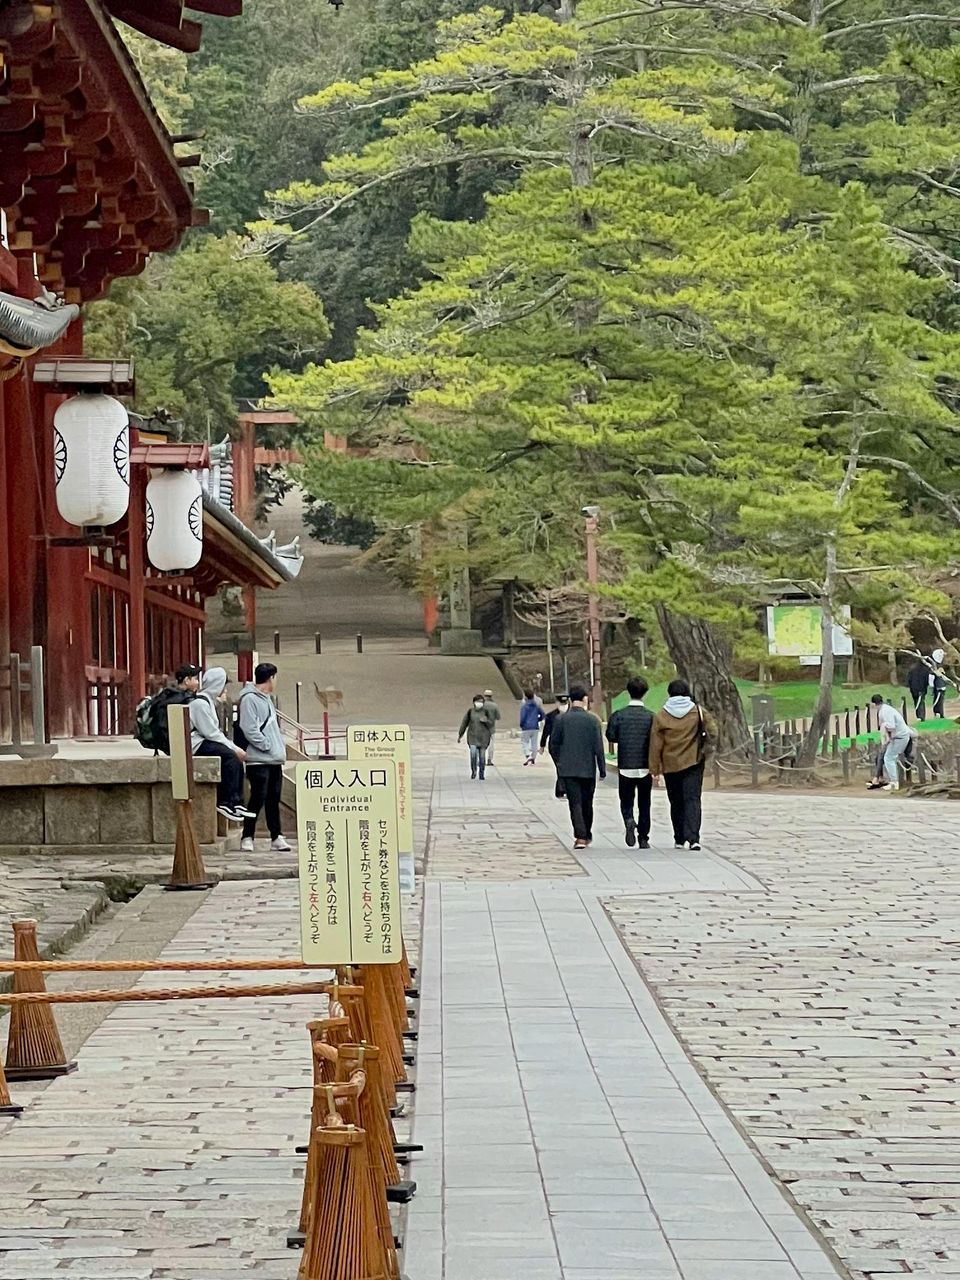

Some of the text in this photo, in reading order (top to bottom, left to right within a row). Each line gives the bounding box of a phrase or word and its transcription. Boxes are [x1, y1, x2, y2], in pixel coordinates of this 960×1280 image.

[353, 730, 405, 743] 団体入口
[304, 769, 387, 789] 個人入口
[319, 795, 373, 804] Individual
[322, 804, 370, 812] Entrance
[305, 820, 321, 945] 階段を上がって左へどうぞ
[324, 820, 338, 926] 入堂券をご購入の方は
[358, 819, 374, 944] 階段を上がって右へどうぞ
[377, 819, 392, 954] セット券などをお持ちの方は
